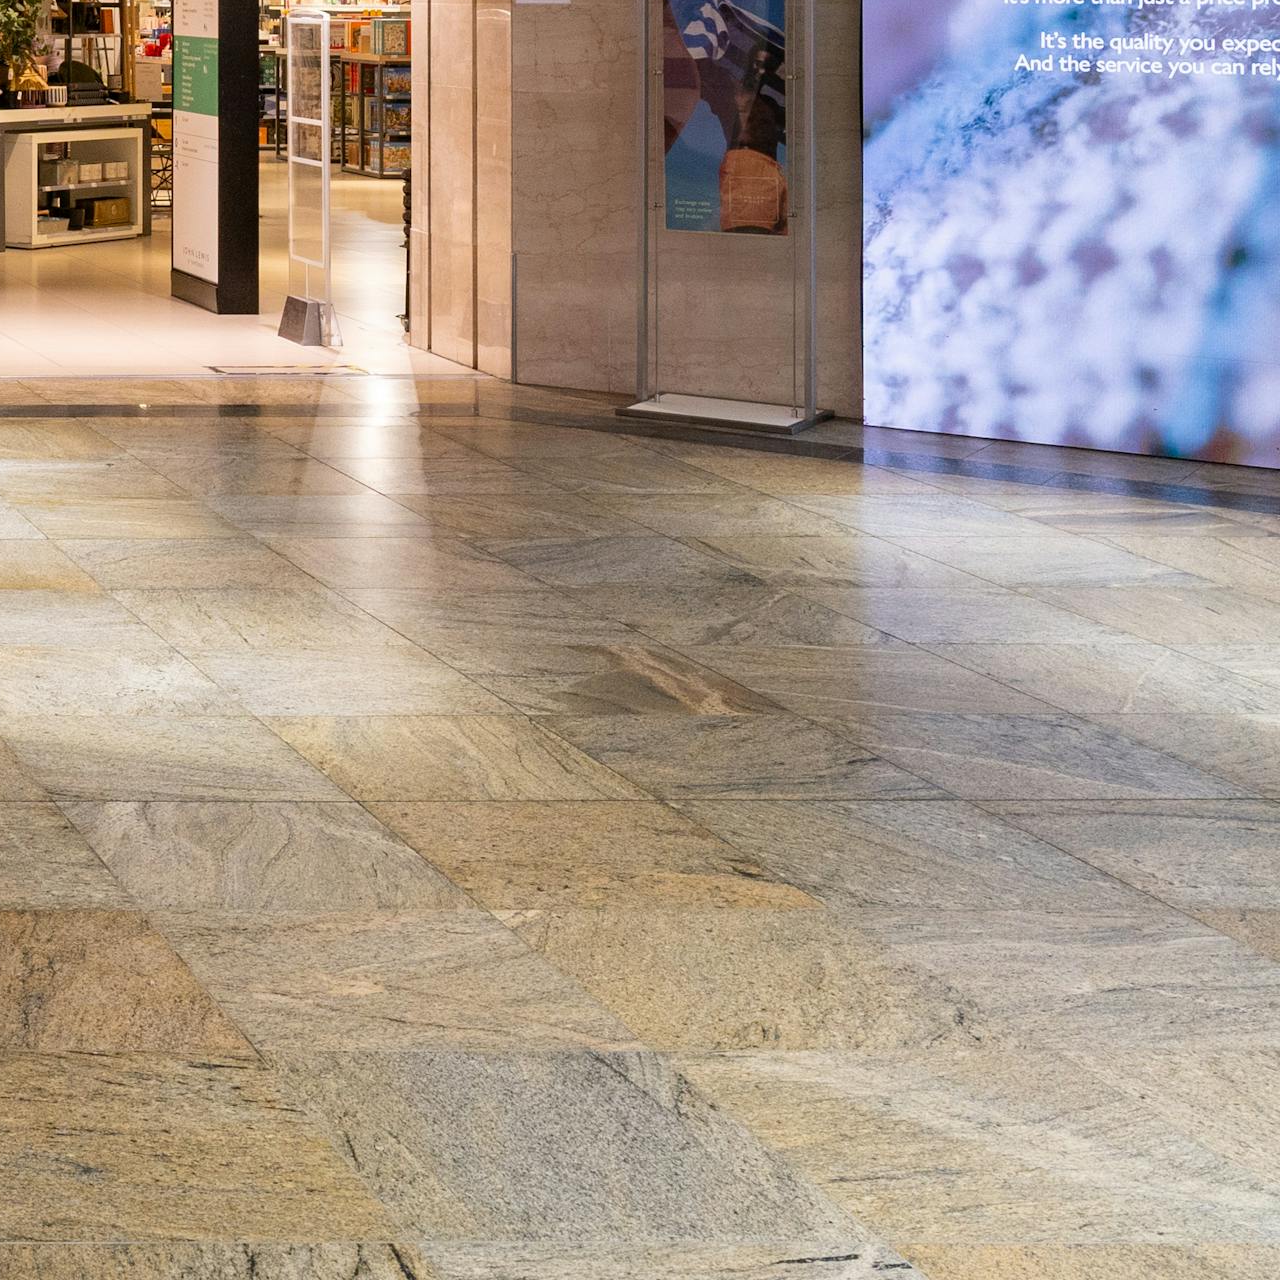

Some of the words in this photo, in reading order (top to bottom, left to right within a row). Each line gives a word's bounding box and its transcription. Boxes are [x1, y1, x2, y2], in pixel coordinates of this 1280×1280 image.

[1040, 31, 1067, 50] It's
[1072, 31, 1104, 49] the
[1109, 33, 1174, 55] quality
[1178, 38, 1216, 55] you
[1014, 54, 1053, 72] And
[1058, 54, 1091, 72] the
[1096, 57, 1163, 73] service
[1168, 61, 1205, 78] you
[1211, 61, 1245, 75] can
